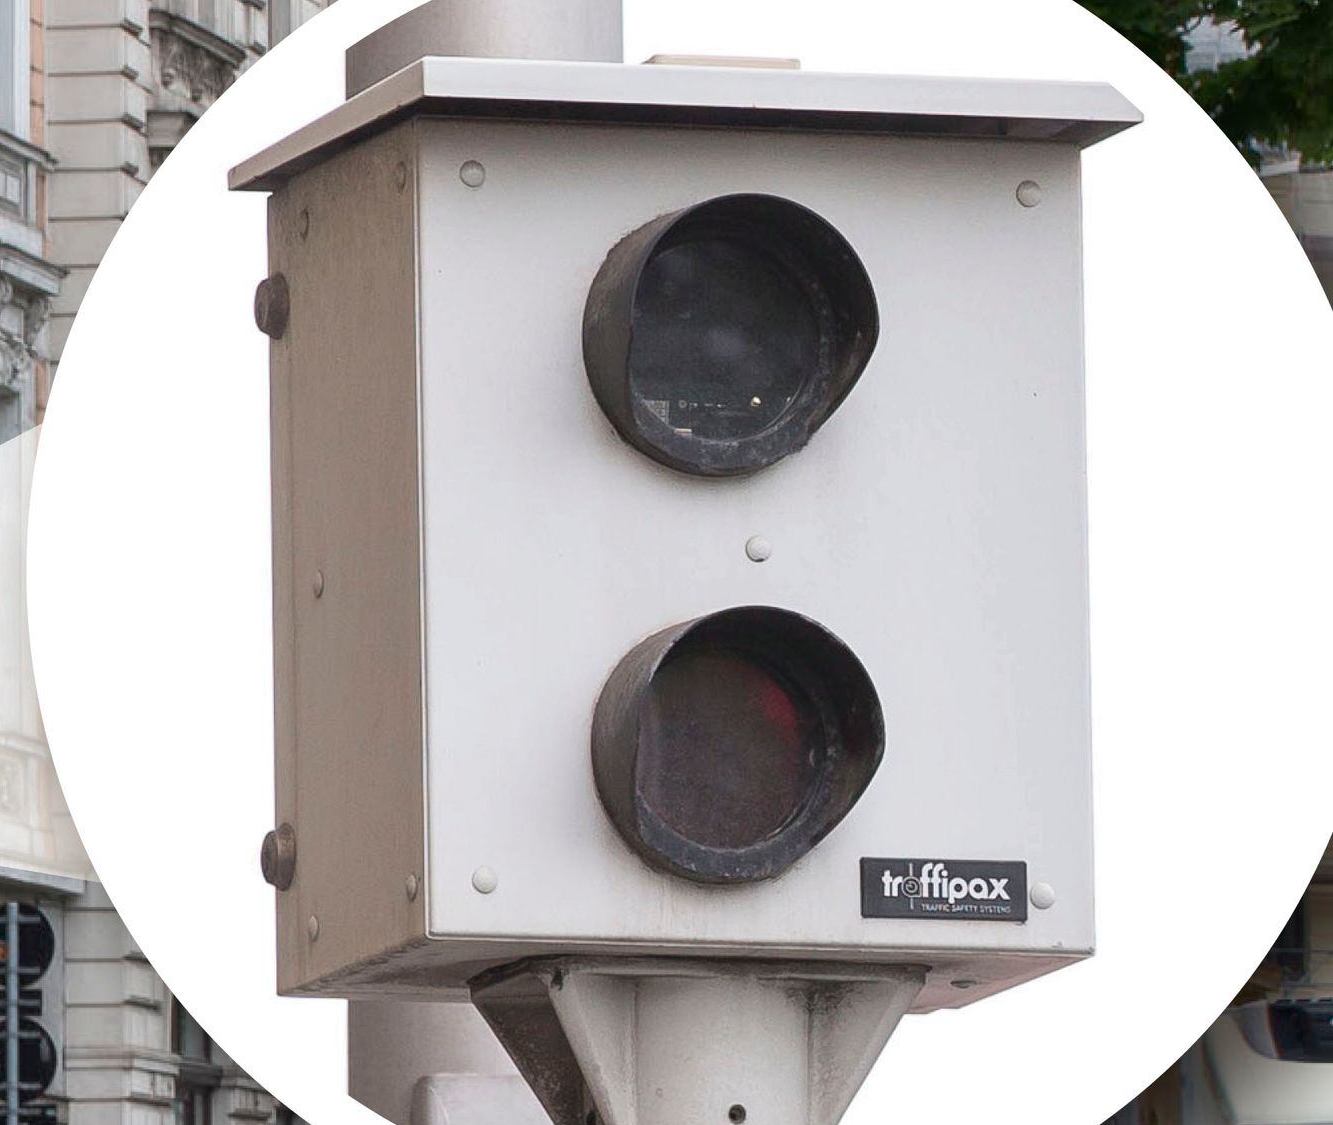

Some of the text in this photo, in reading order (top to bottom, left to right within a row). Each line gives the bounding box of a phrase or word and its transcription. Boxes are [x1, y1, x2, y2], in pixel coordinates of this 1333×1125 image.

[881, 863, 1011, 904] traffipax
[921, 903, 950, 913] TRAFFIC
[952, 904, 978, 914] SAFETY
